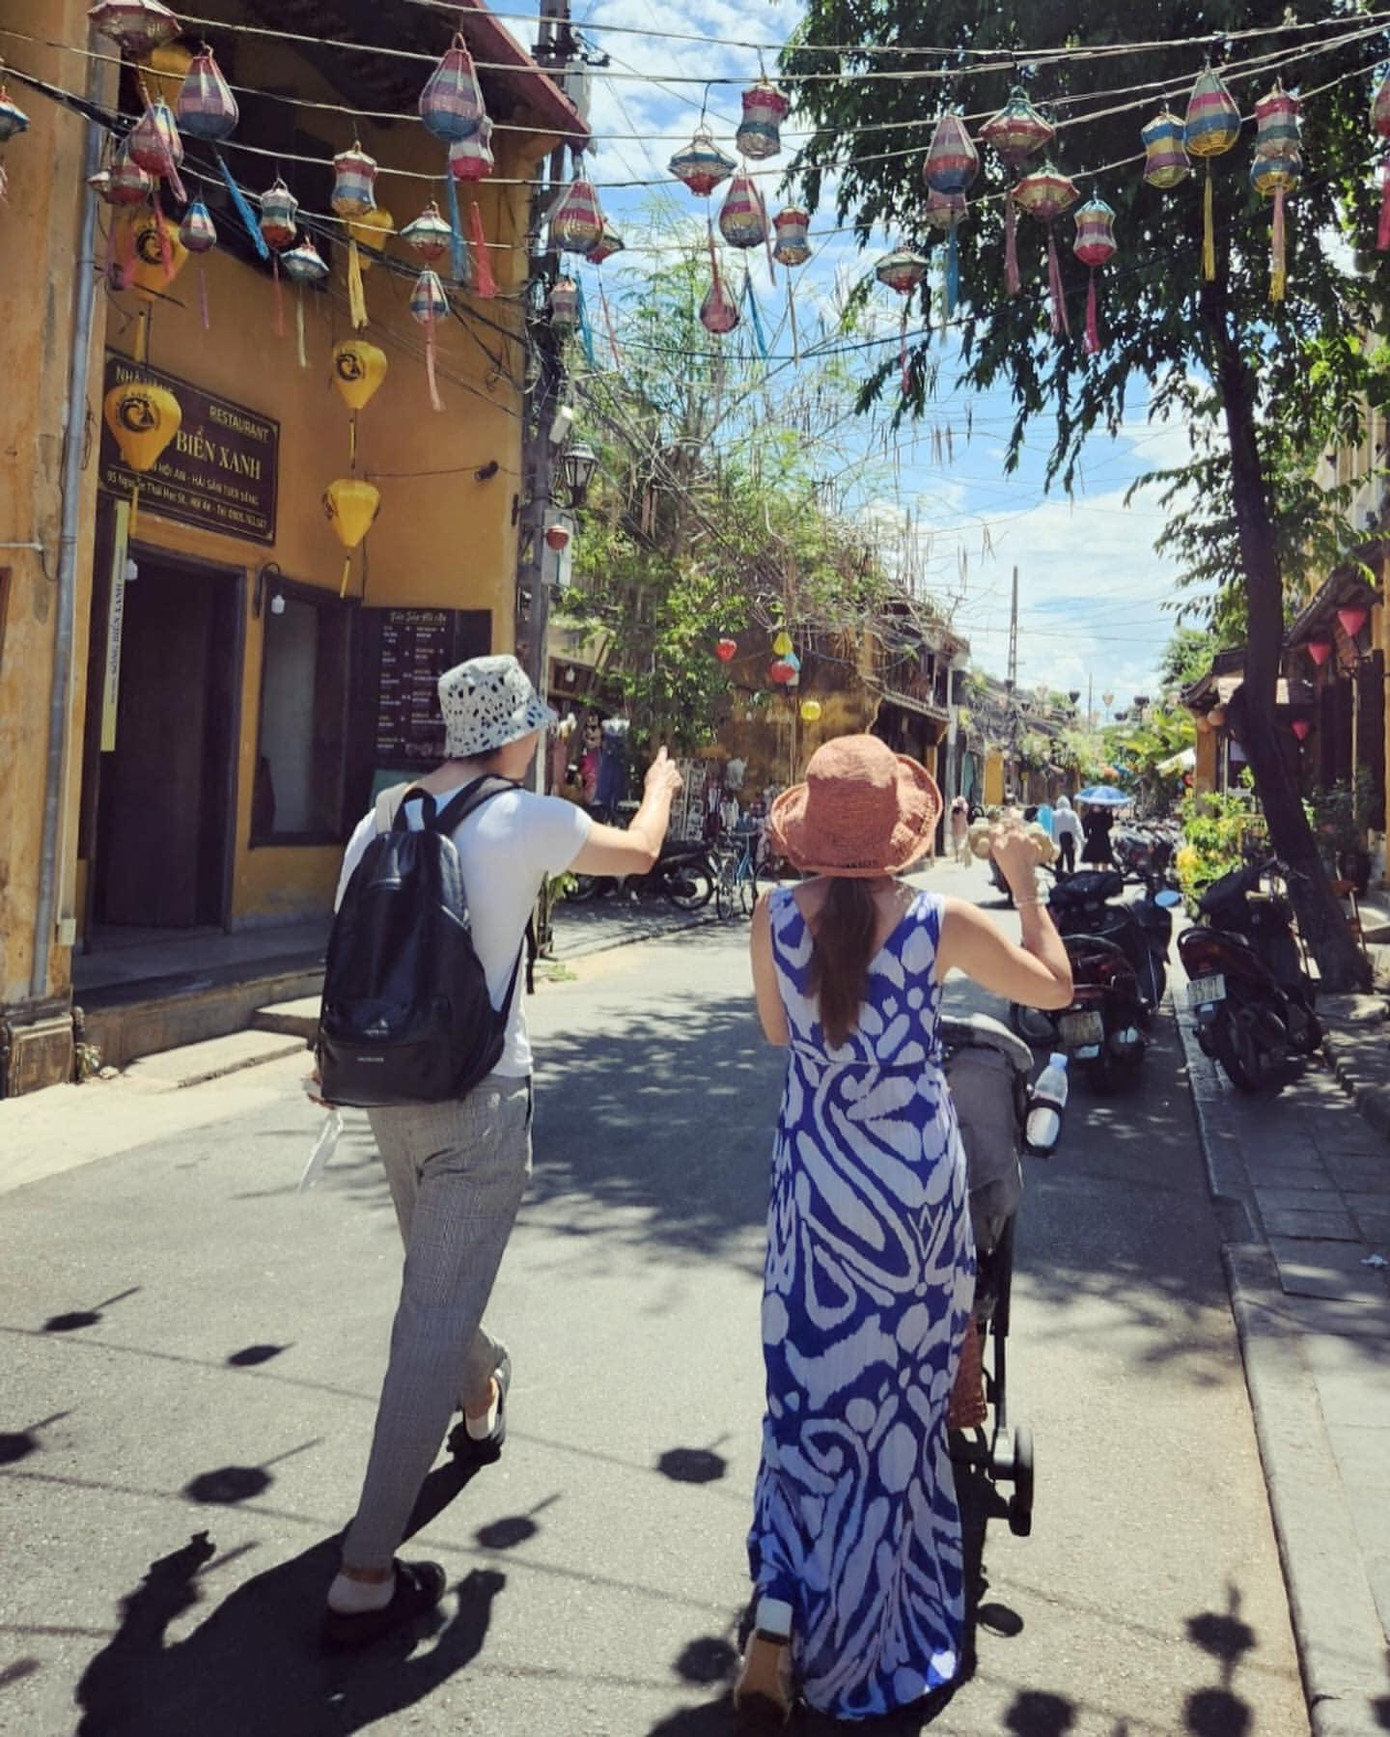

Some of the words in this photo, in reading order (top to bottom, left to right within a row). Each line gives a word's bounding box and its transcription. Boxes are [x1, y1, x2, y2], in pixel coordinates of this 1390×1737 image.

[209, 405, 269, 442] RESTAURANT
[176, 425, 216, 463] BIỂN
[219, 446, 261, 480] XANH
